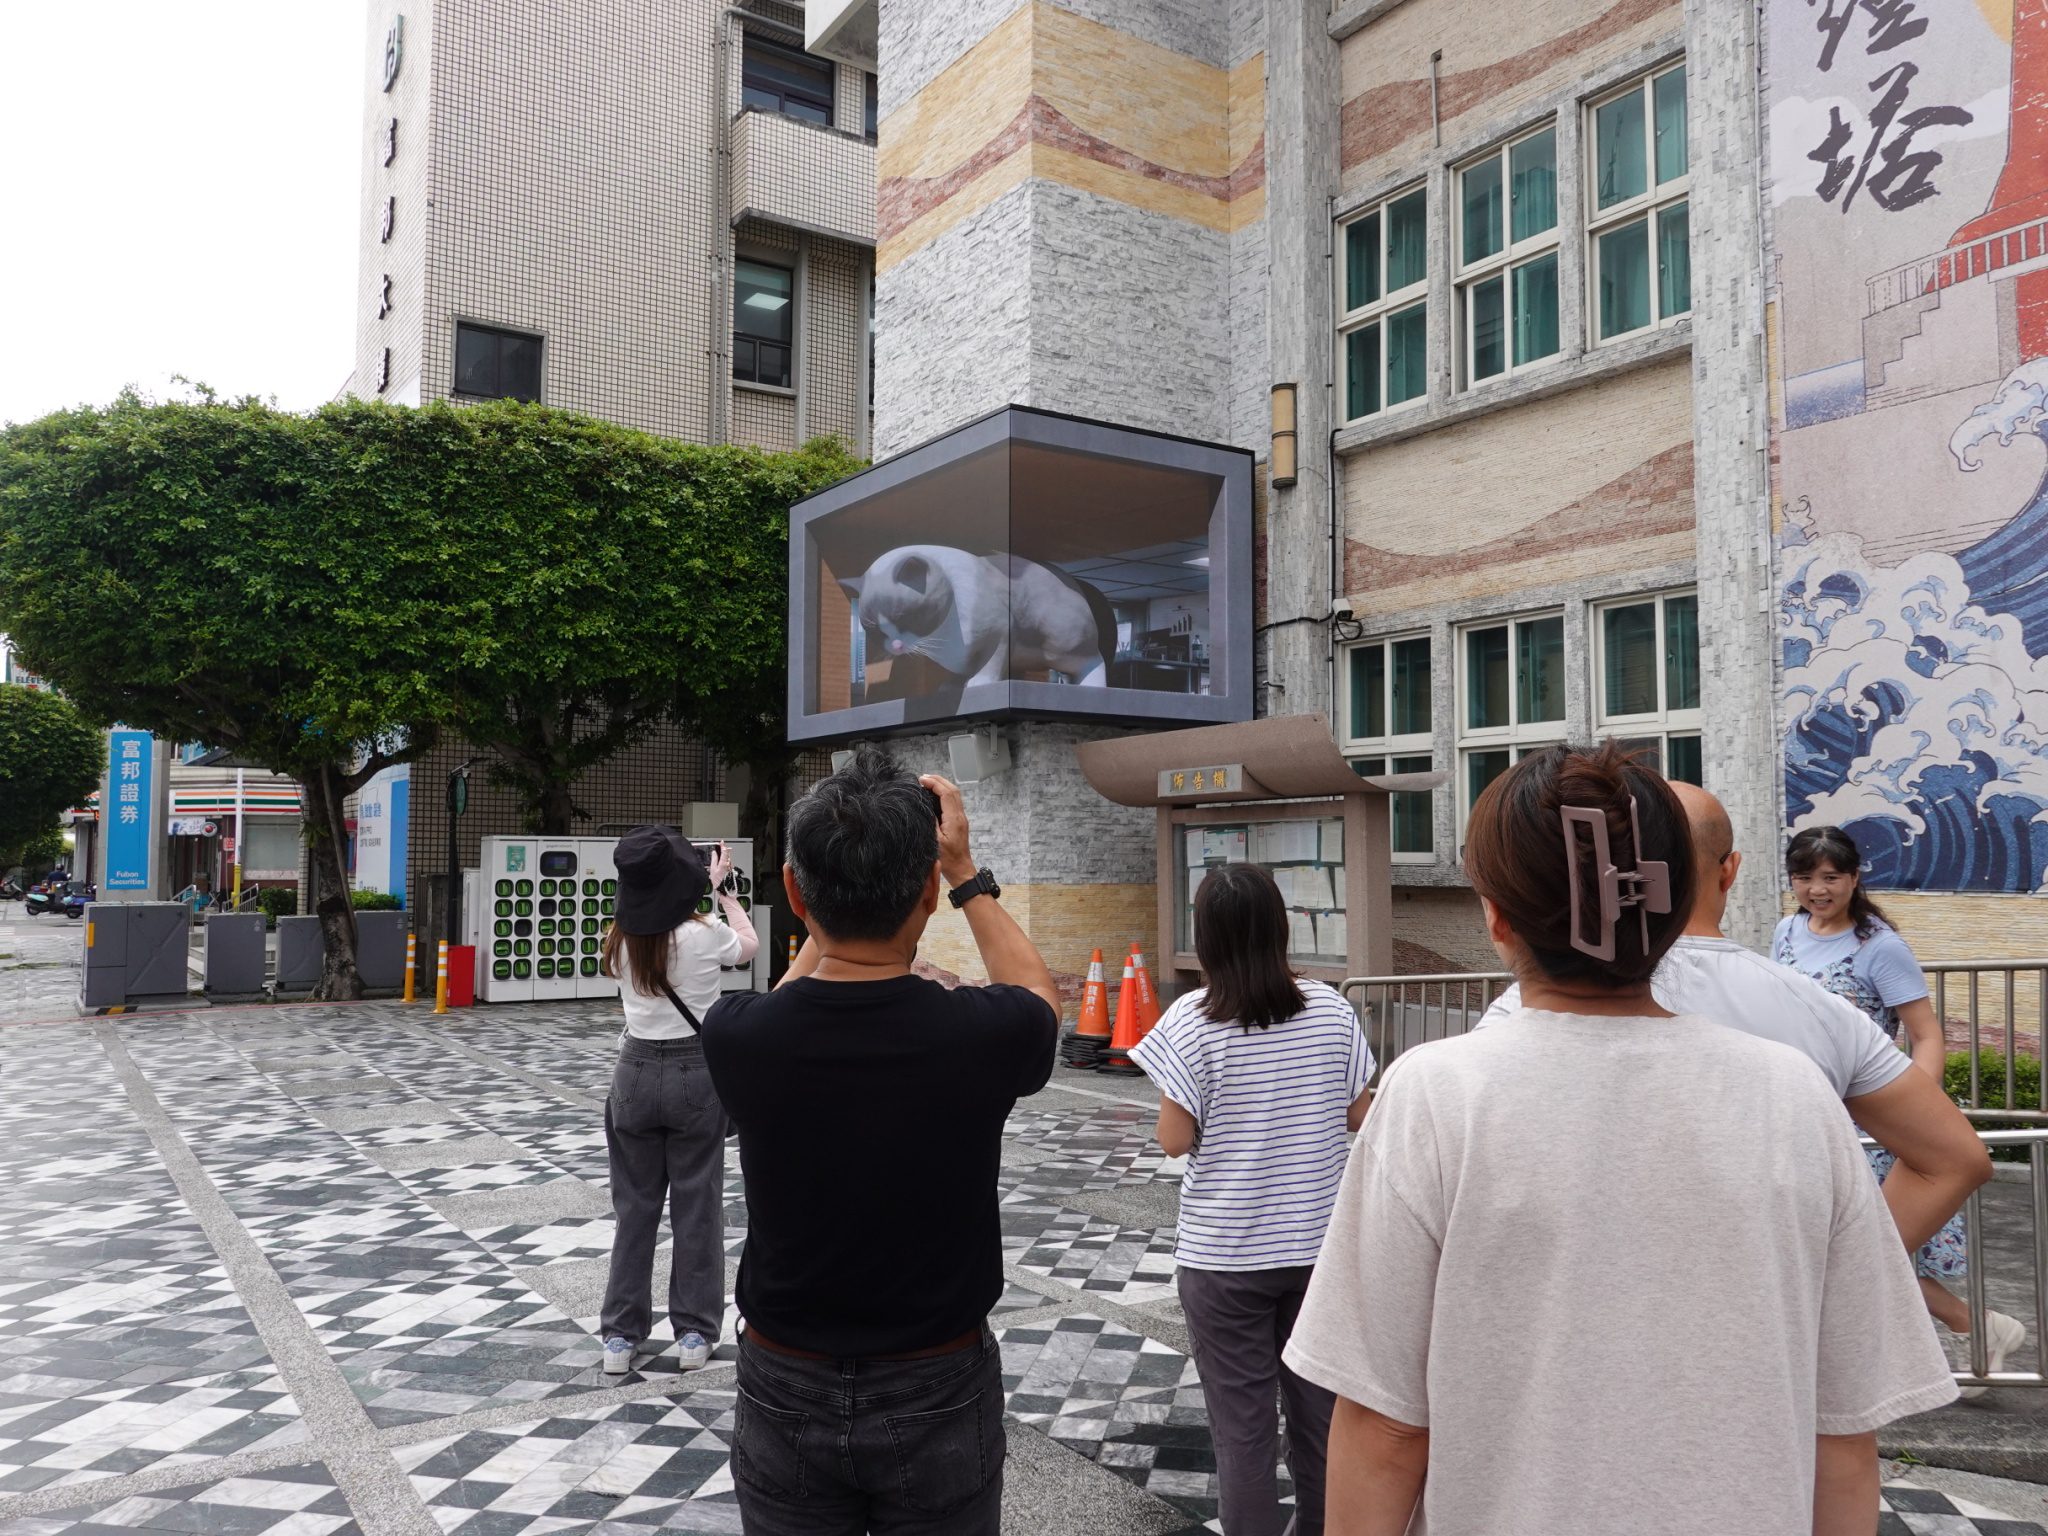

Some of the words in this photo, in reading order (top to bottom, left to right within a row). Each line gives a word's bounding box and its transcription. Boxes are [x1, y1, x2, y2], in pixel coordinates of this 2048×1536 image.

[120, 740, 141, 824] 富邦證券
[1173, 769, 1226, 792] 佈告欄
[116, 870, 139, 878] Fubon
[109, 878, 145, 886] Securities
